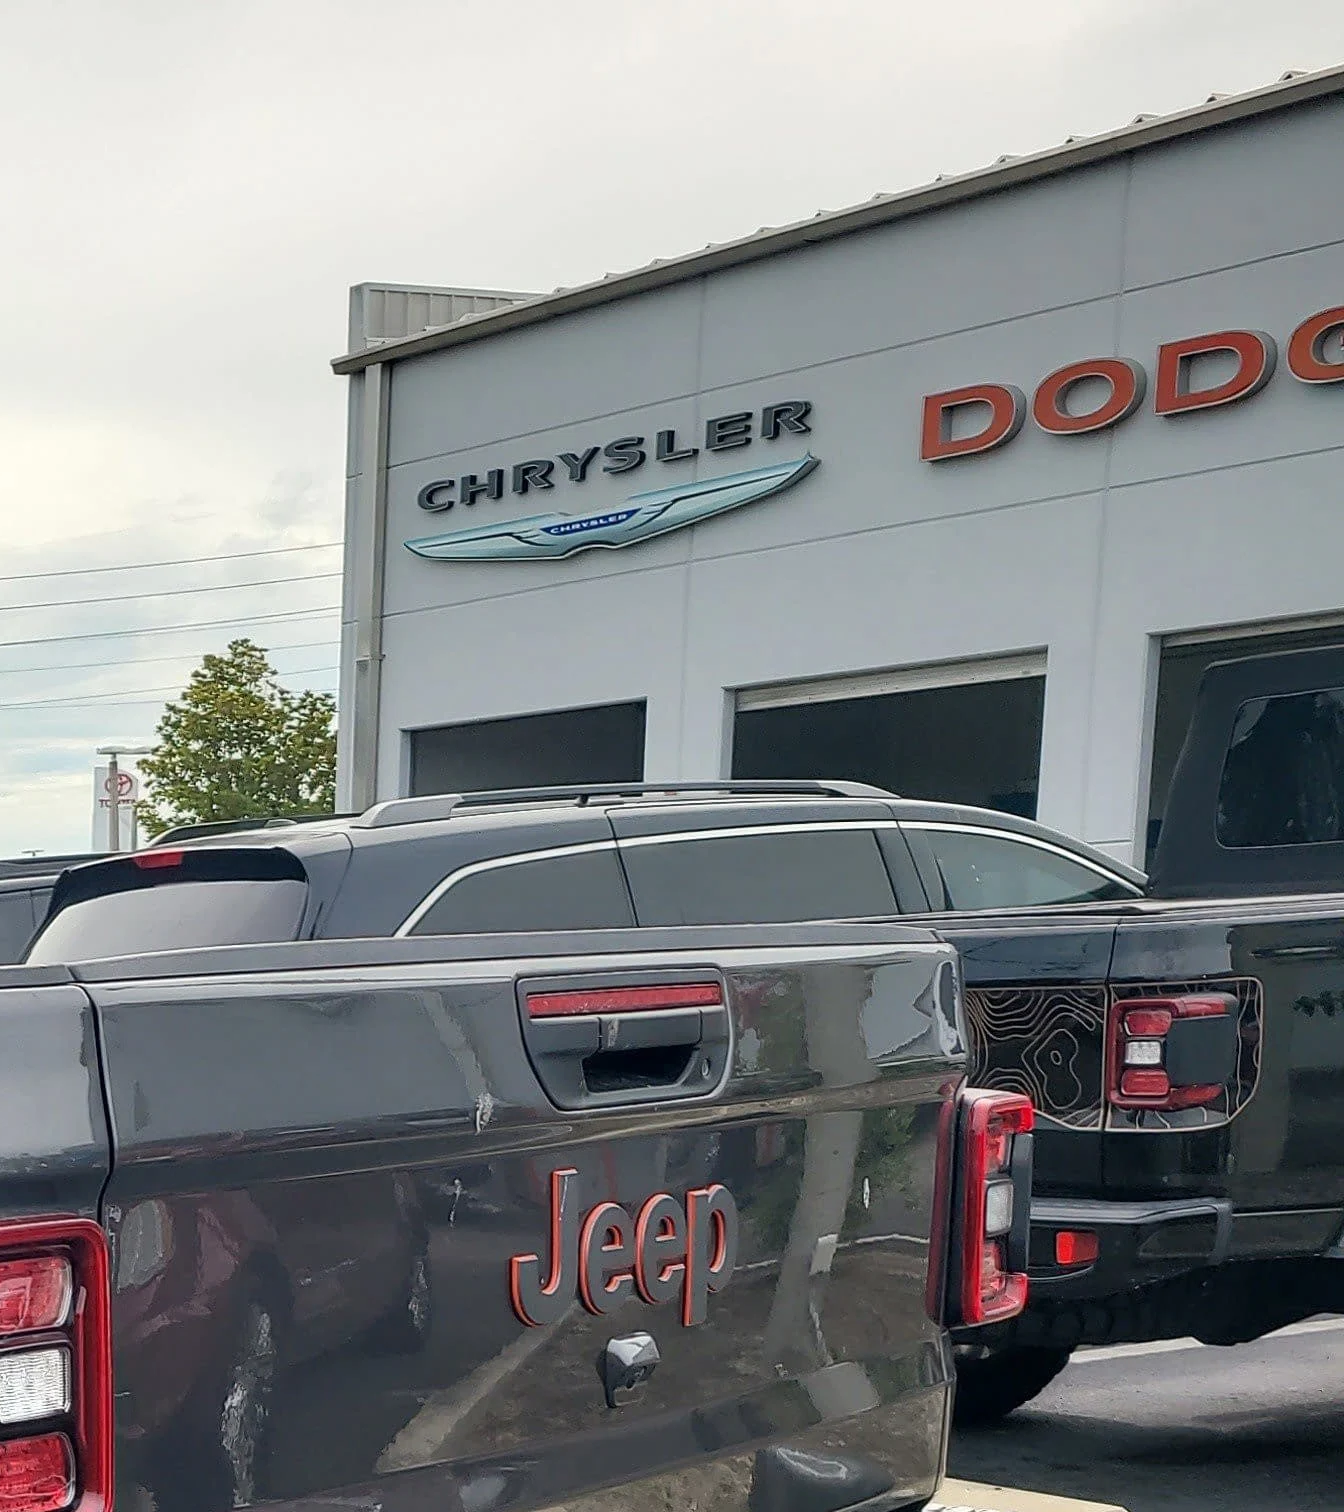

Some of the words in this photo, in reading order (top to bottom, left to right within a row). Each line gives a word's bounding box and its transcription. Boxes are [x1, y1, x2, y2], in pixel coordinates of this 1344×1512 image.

[417, 399, 813, 513] CHRYSLER
[550, 513, 628, 534] CHRYSLER
[509, 1167, 739, 1328] Jeep
